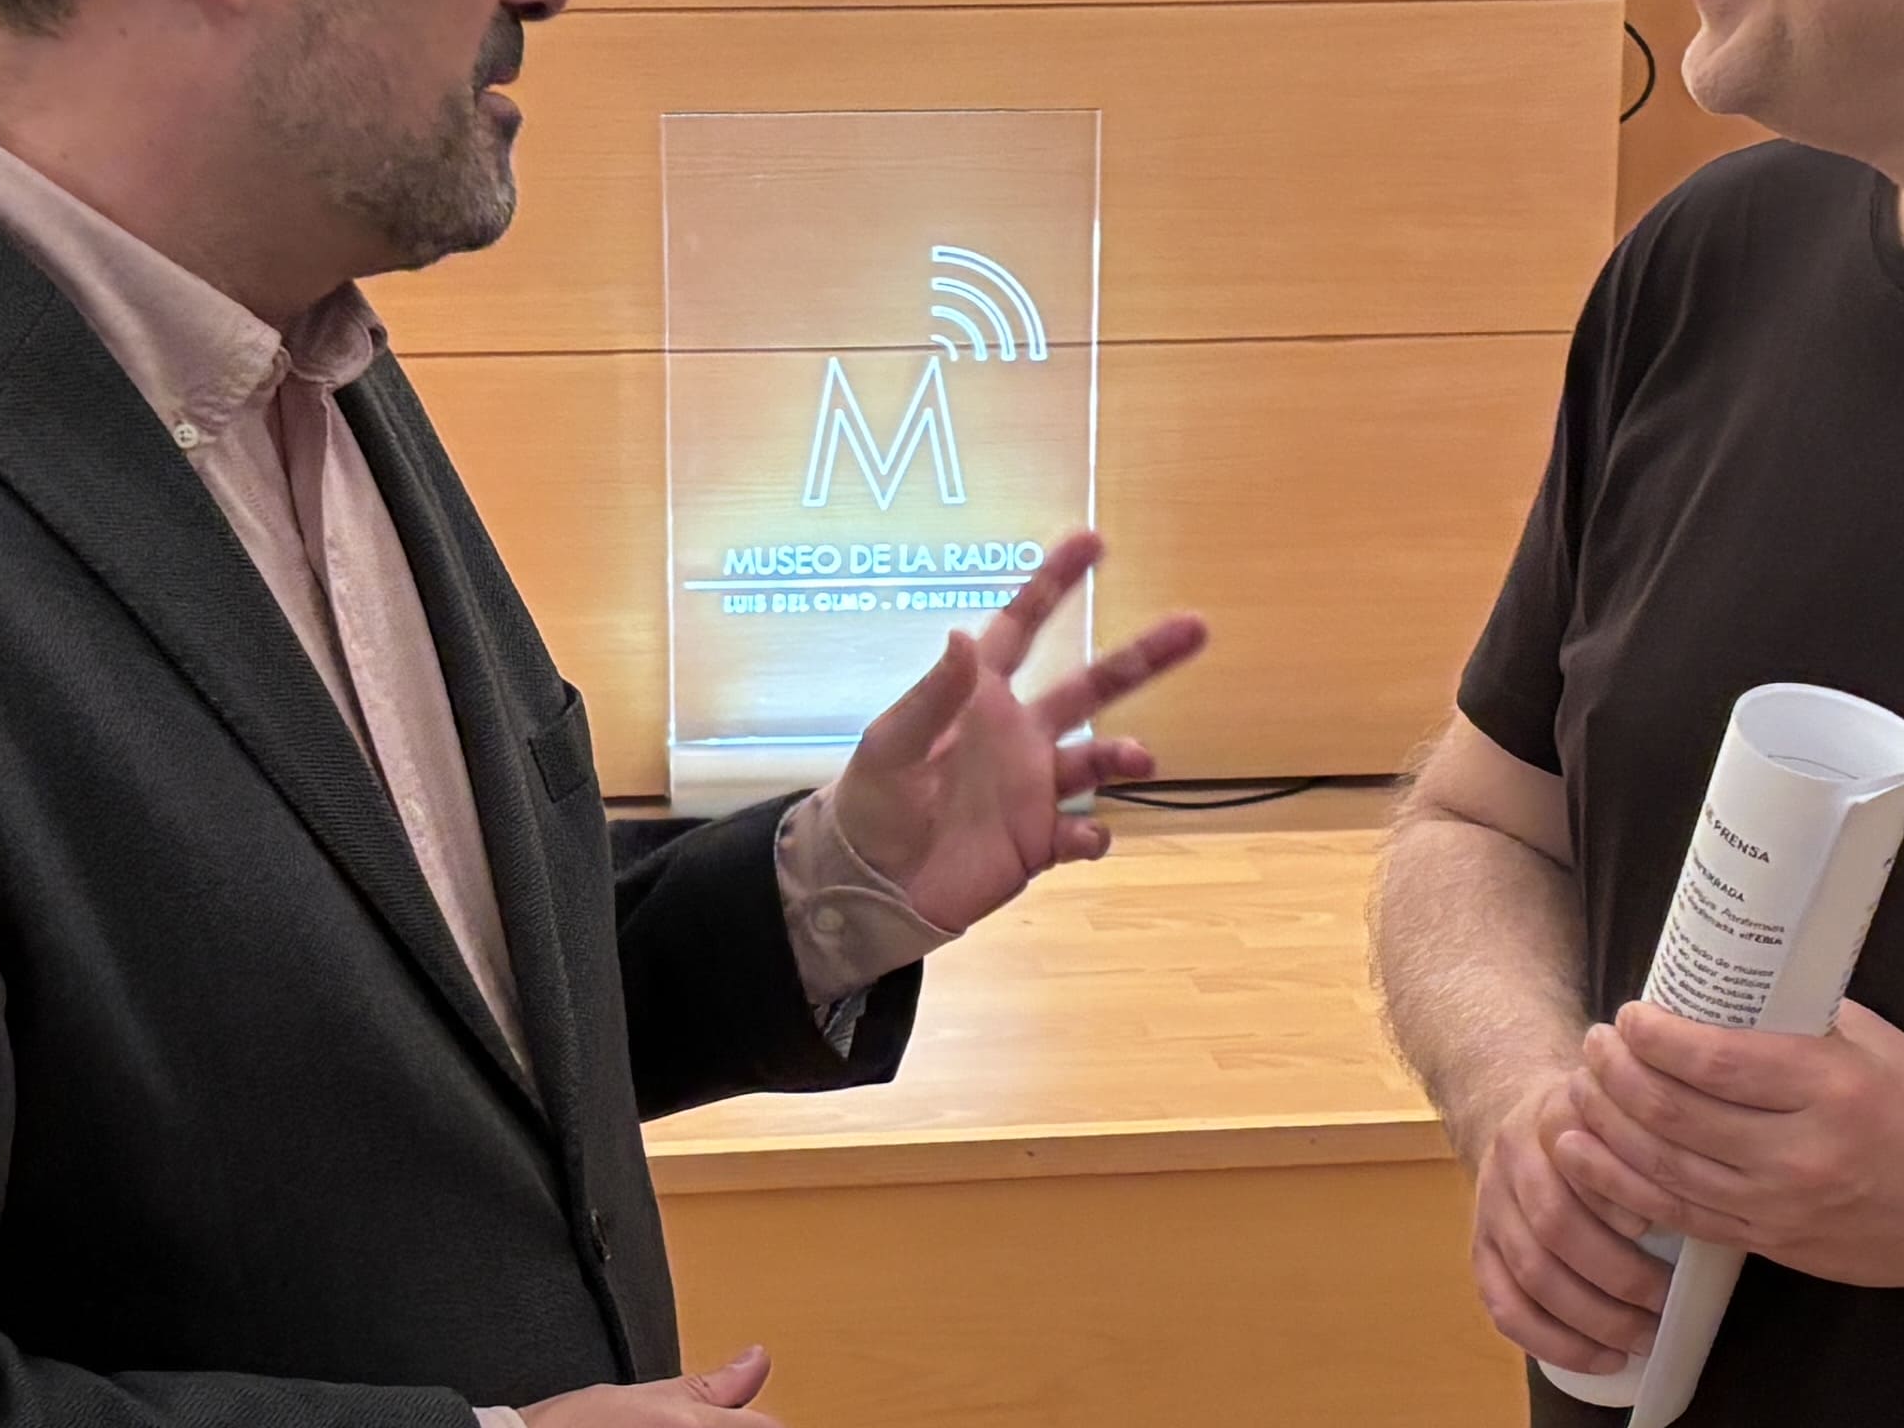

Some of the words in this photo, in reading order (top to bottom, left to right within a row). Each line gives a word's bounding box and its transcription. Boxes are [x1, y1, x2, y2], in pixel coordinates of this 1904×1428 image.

[801, 355, 967, 511] M
[723, 544, 842, 577] MUSEO
[850, 543, 892, 574] DE
[898, 543, 937, 573] LA
[943, 540, 1045, 572] RADIO
[723, 594, 767, 614] LUIS
[772, 593, 810, 613] DEL
[813, 592, 877, 612] OLMO
[1713, 819, 1770, 864] PRENSA
